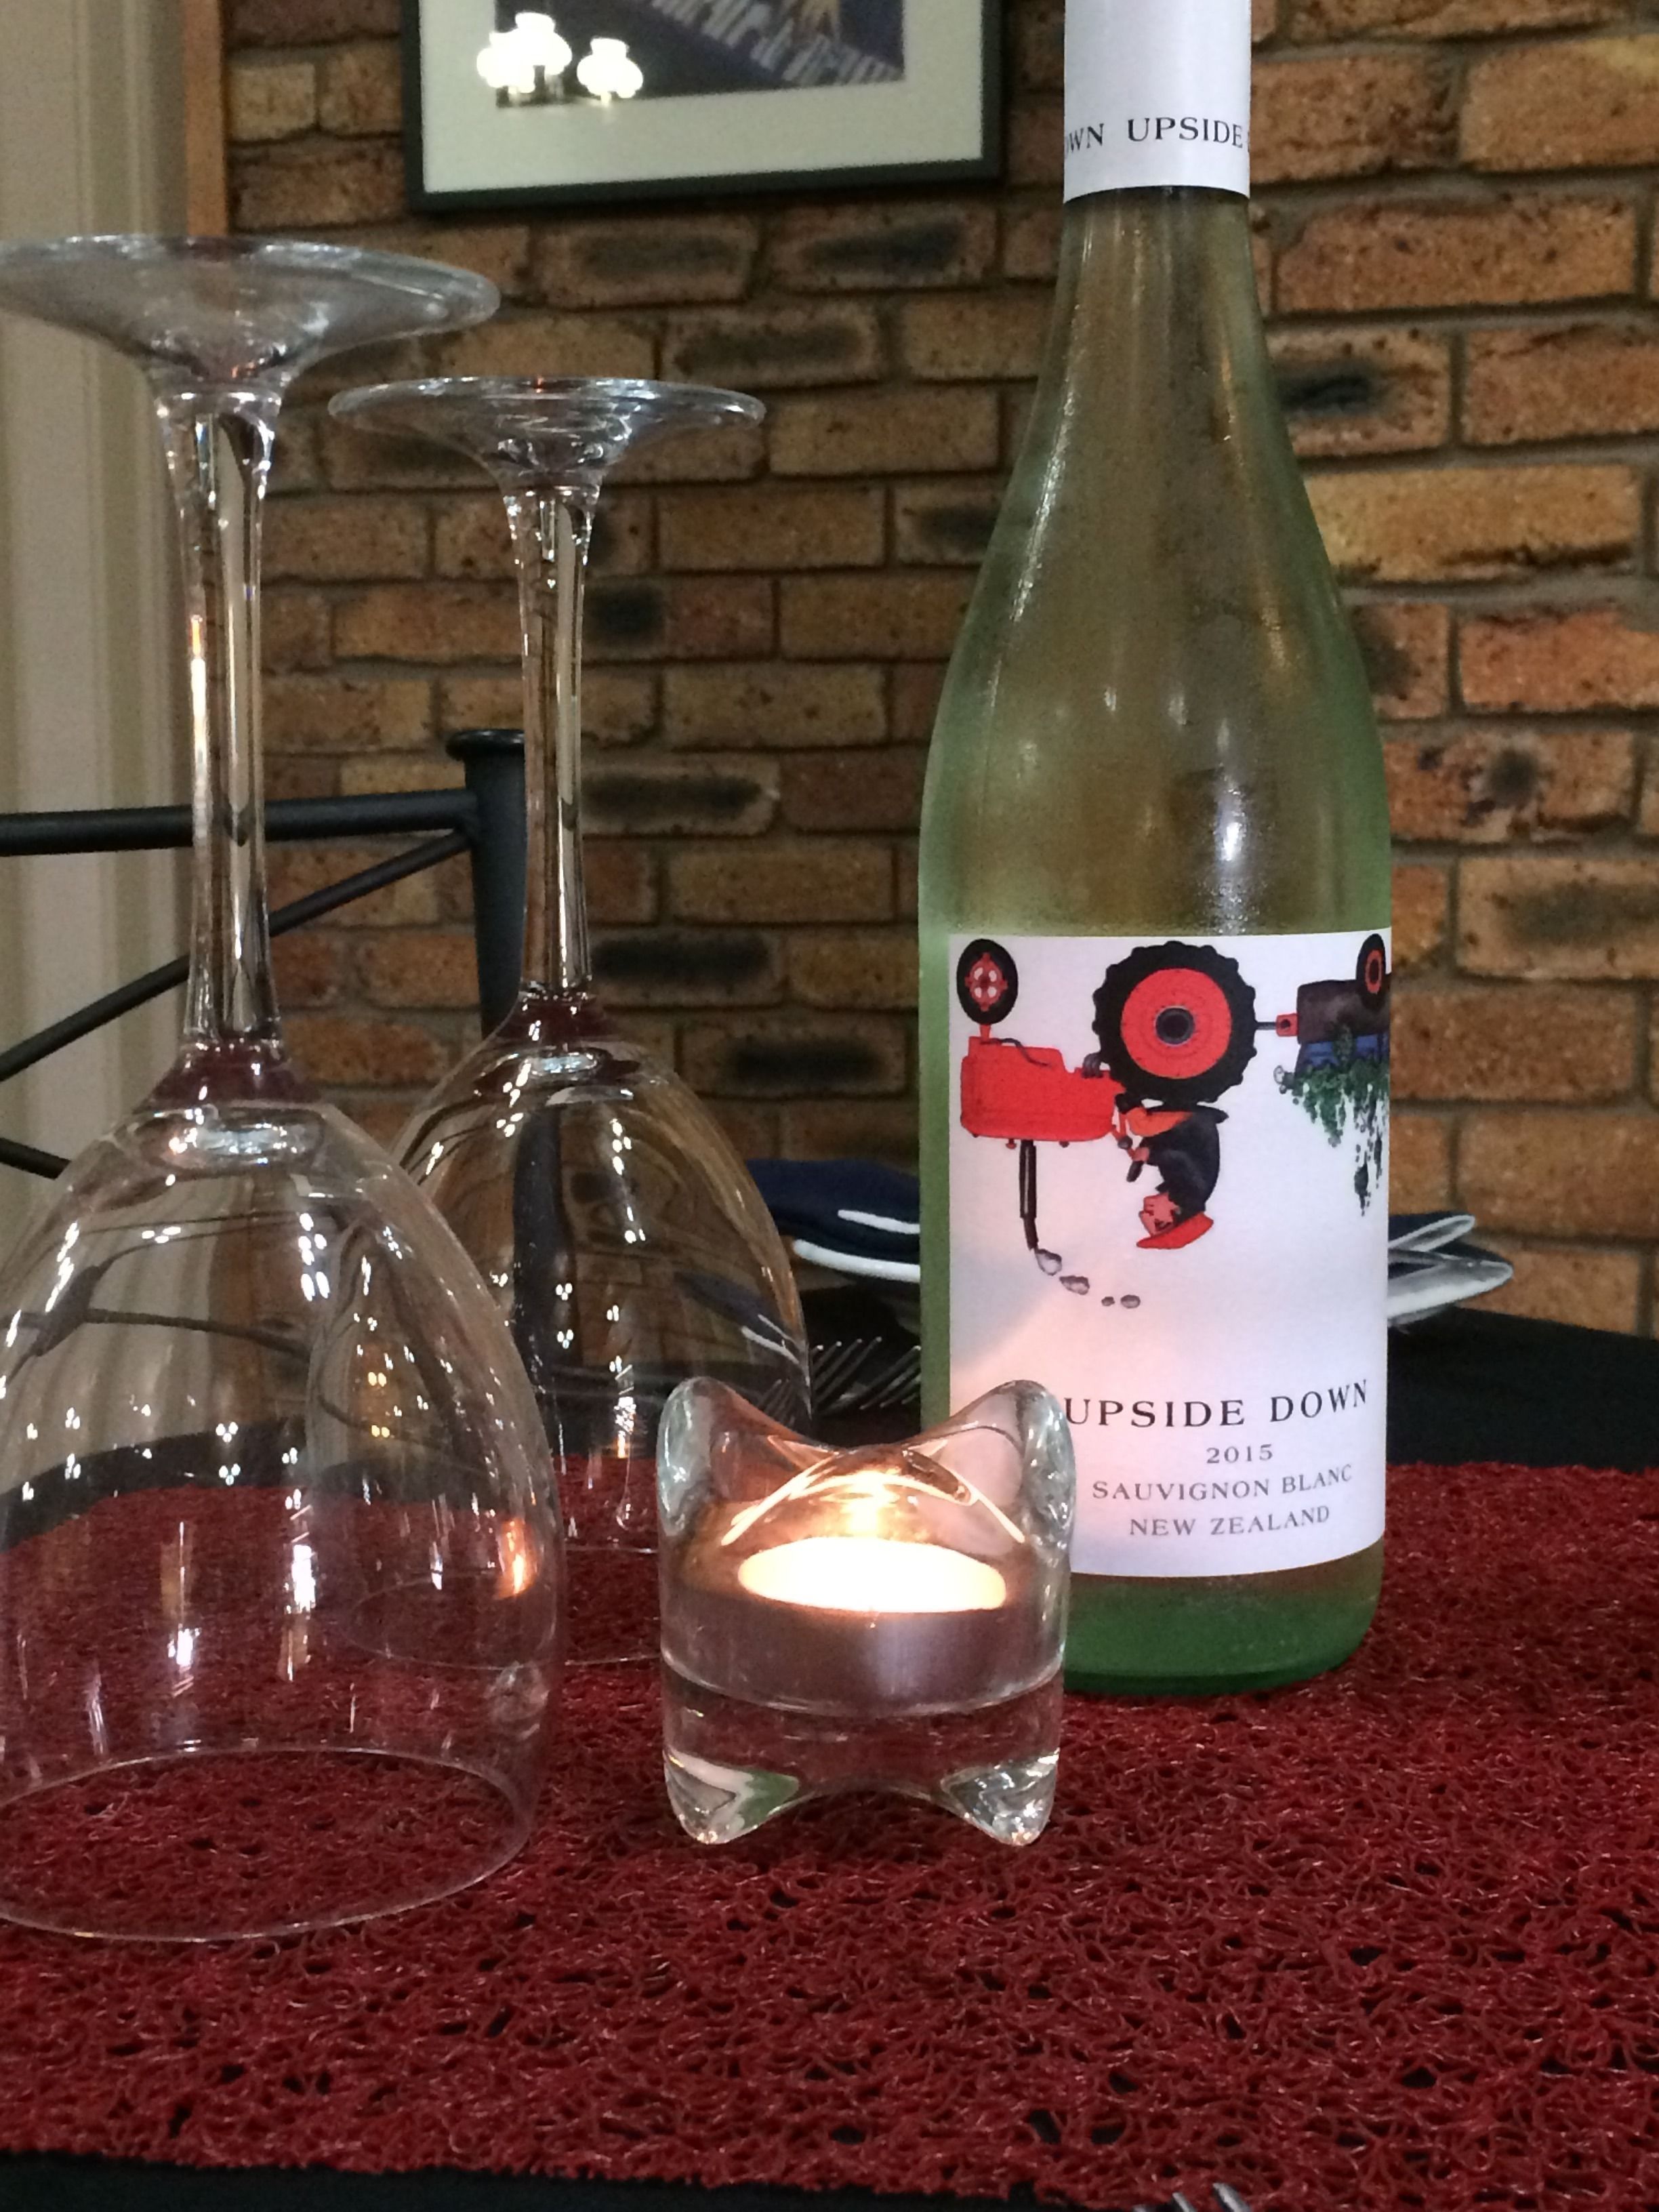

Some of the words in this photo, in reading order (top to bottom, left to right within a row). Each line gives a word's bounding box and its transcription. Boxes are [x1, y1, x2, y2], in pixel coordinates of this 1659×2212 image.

[1127, 117, 1243, 148] UPSIDE
[1064, 1398, 1245, 1427] UPSIDE
[1269, 1379, 1368, 1422] DOWN
[1206, 1443, 1273, 1464] 2015
[1092, 1478, 1270, 1501] SAUVIGNON
[1281, 1464, 1352, 1494] BLANC
[1129, 1518, 1196, 1536] NEW
[1210, 1504, 1330, 1536] ZEALAND
